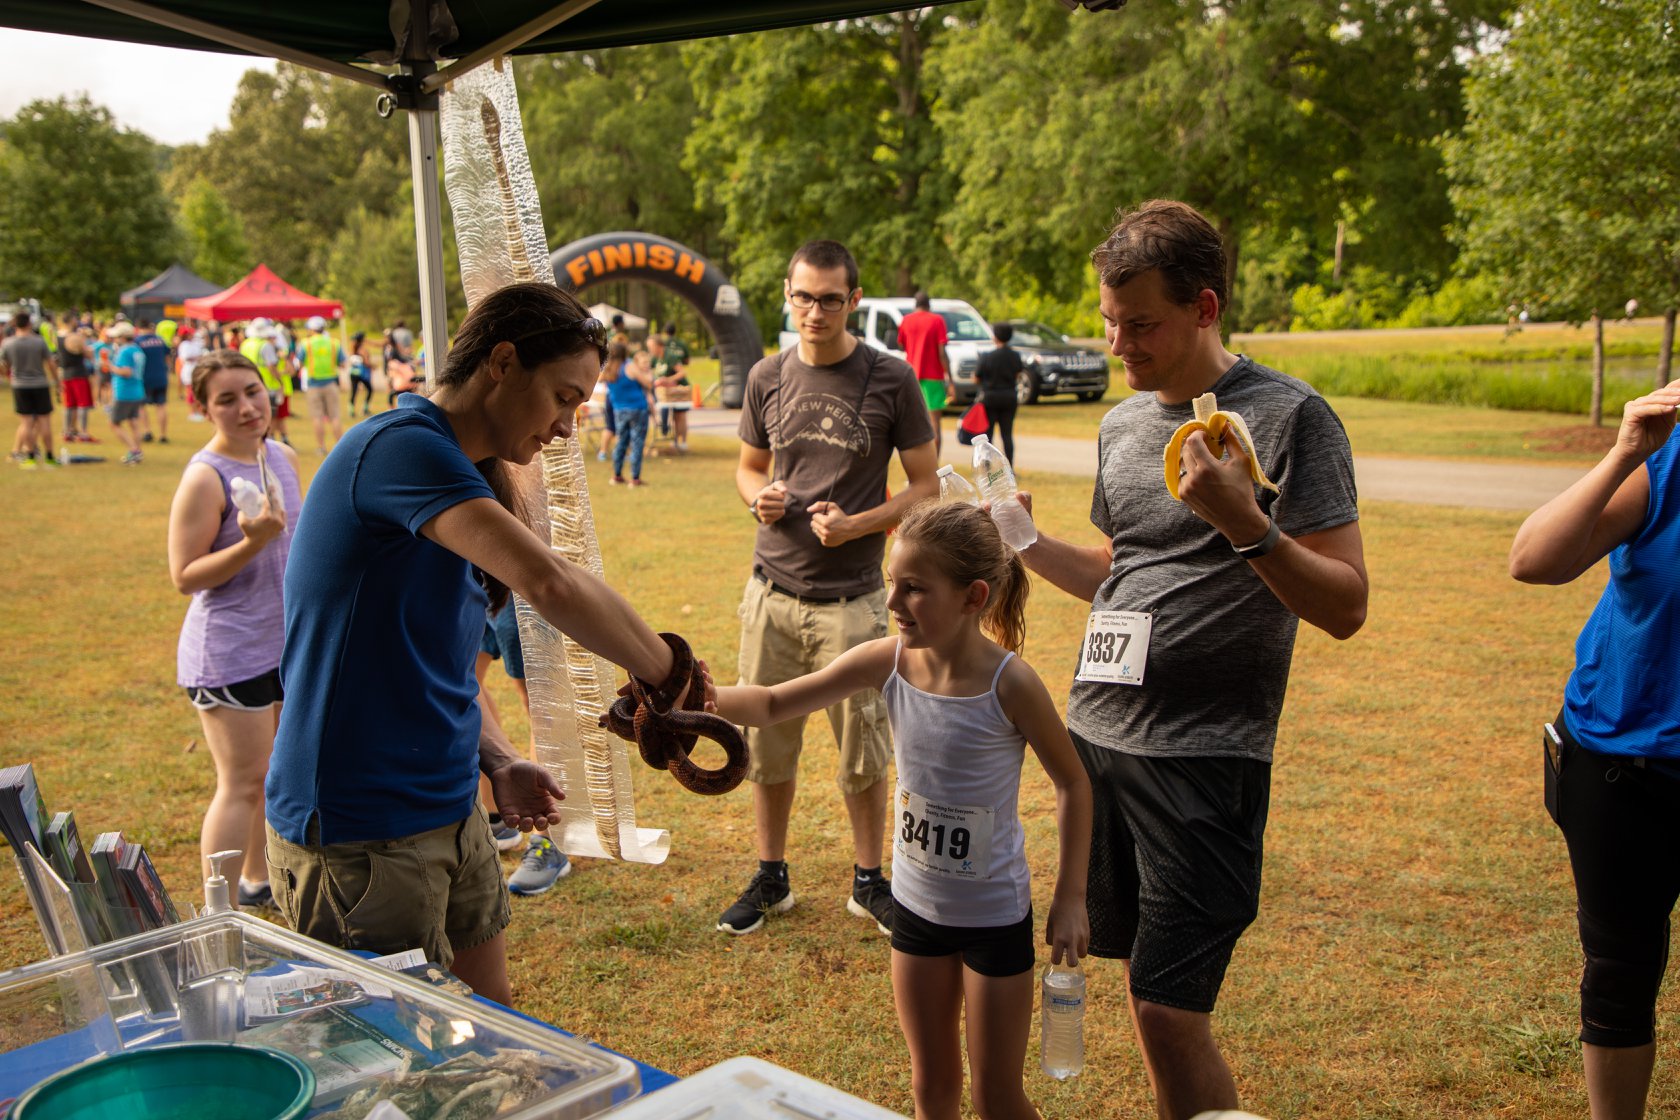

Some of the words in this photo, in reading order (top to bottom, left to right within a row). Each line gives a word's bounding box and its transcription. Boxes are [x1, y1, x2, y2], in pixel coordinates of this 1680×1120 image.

[565, 242, 705, 287] FINISH
[1086, 631, 1132, 664] 3337
[902, 810, 971, 860] 3419
